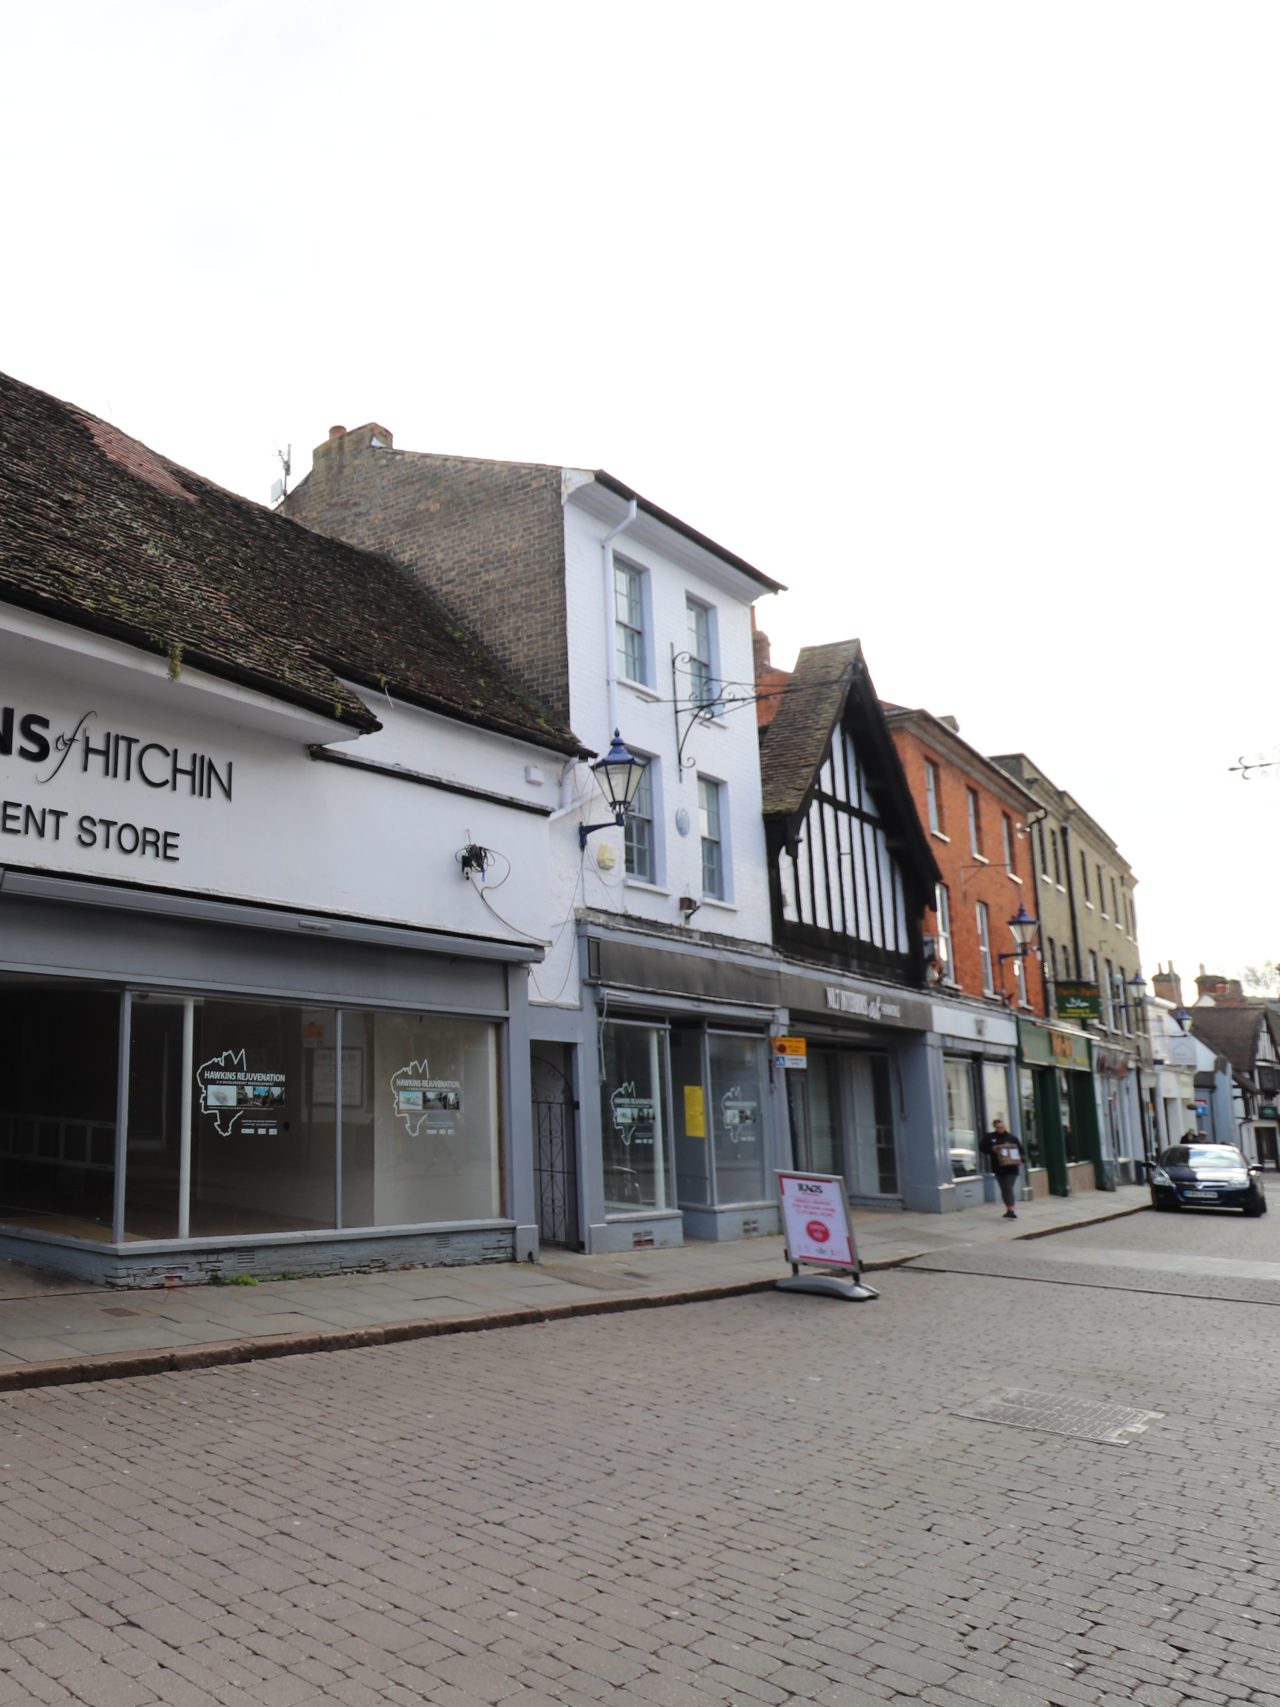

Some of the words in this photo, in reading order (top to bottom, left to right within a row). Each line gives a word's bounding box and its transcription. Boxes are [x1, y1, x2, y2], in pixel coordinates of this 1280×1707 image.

[35, 711, 98, 784] of
[83, 729, 234, 802] HITCHIN
[77, 815, 180, 862] STORE
[204, 1071, 236, 1080] HAWKINS
[237, 1072, 286, 1082] REJUVENATION
